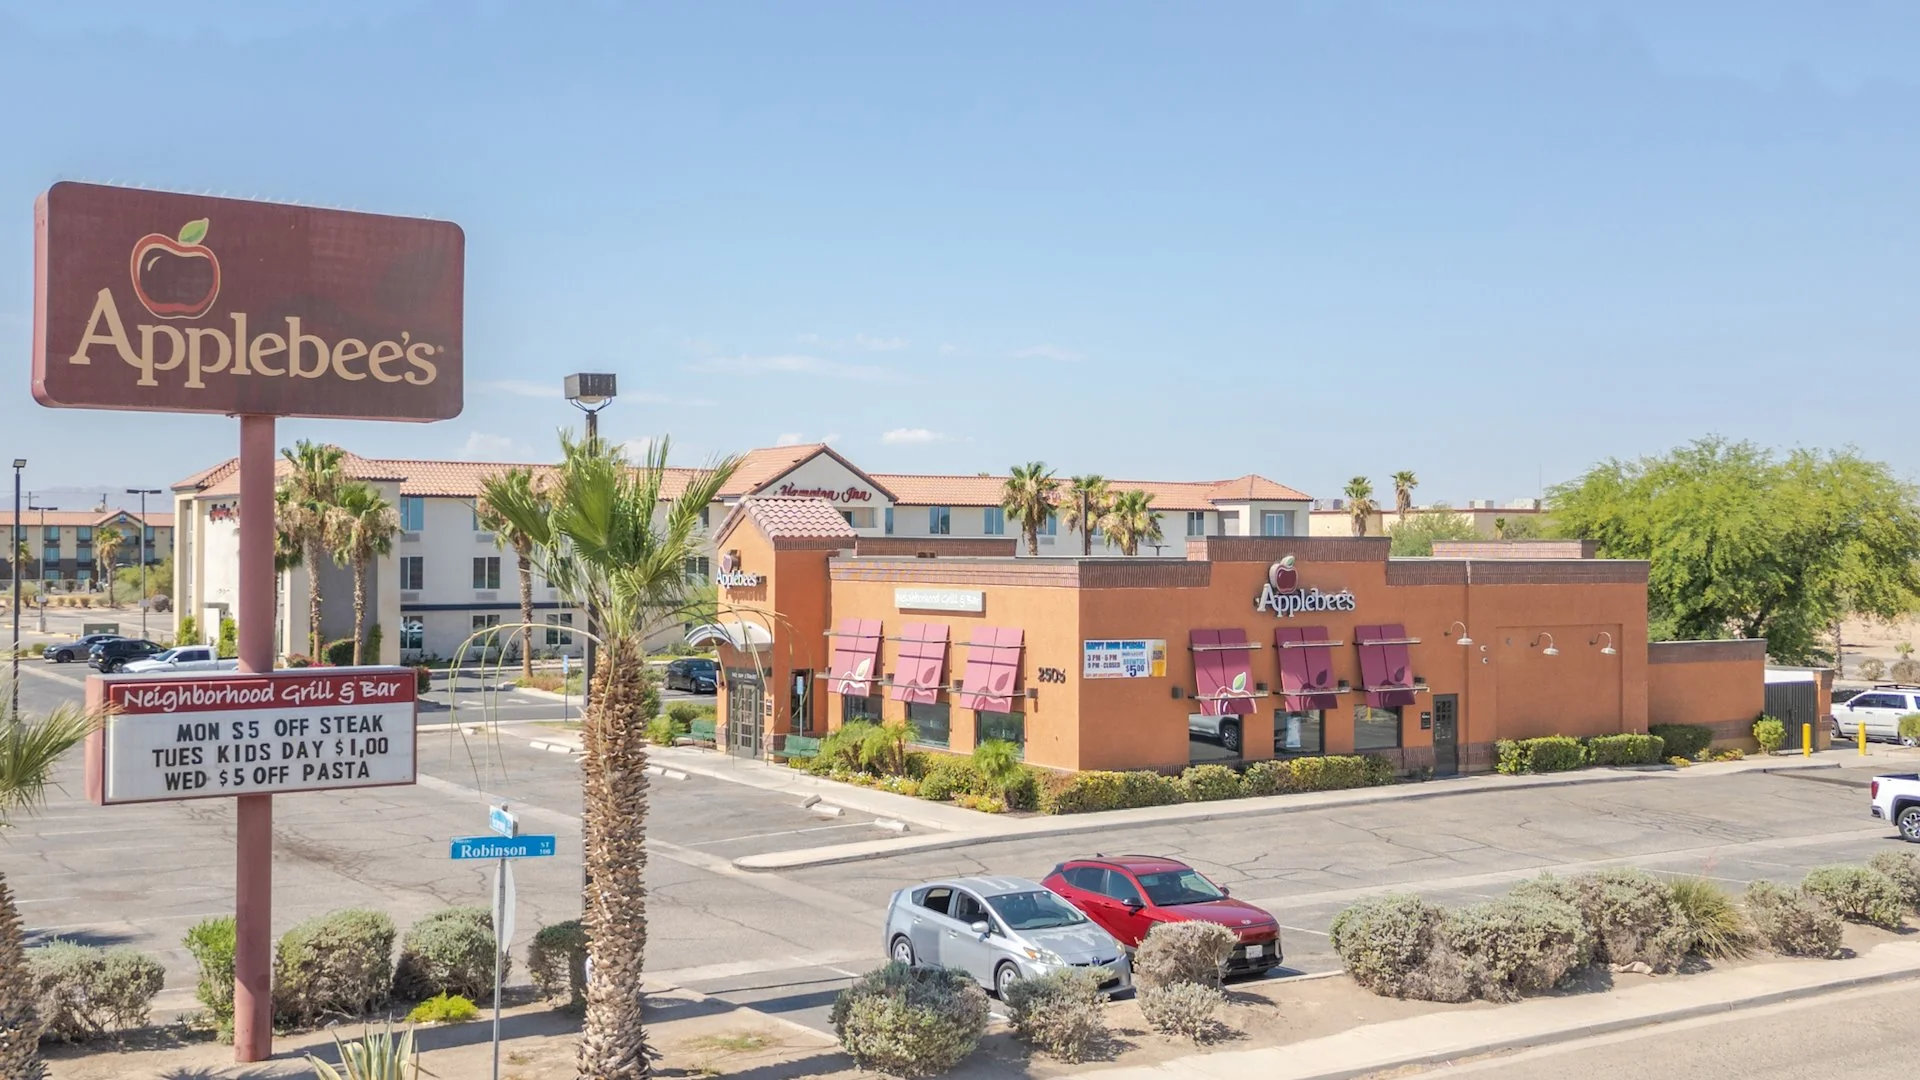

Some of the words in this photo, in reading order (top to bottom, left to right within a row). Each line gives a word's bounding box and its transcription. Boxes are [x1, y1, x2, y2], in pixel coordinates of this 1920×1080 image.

[69, 287, 437, 388] Applebee's
[841, 486, 872, 502] Inn
[1256, 583, 1356, 618] Applebee's
[124, 681, 275, 713] Neighborhood
[281, 680, 334, 704] Grill
[339, 682, 355, 703] &
[362, 680, 401, 698] Bar
[176, 722, 220, 742] MON
[274, 718, 309, 737] OFF
[320, 715, 383, 735] STEAK
[152, 747, 203, 767] TUES
[217, 743, 271, 763] KIDS
[282, 740, 324, 759] DAY
[165, 771, 207, 791] WED
[219, 767, 245, 787] $5
[253, 766, 290, 785] OFF
[302, 761, 370, 781] PASTA
[460, 844, 527, 858] Robinson
